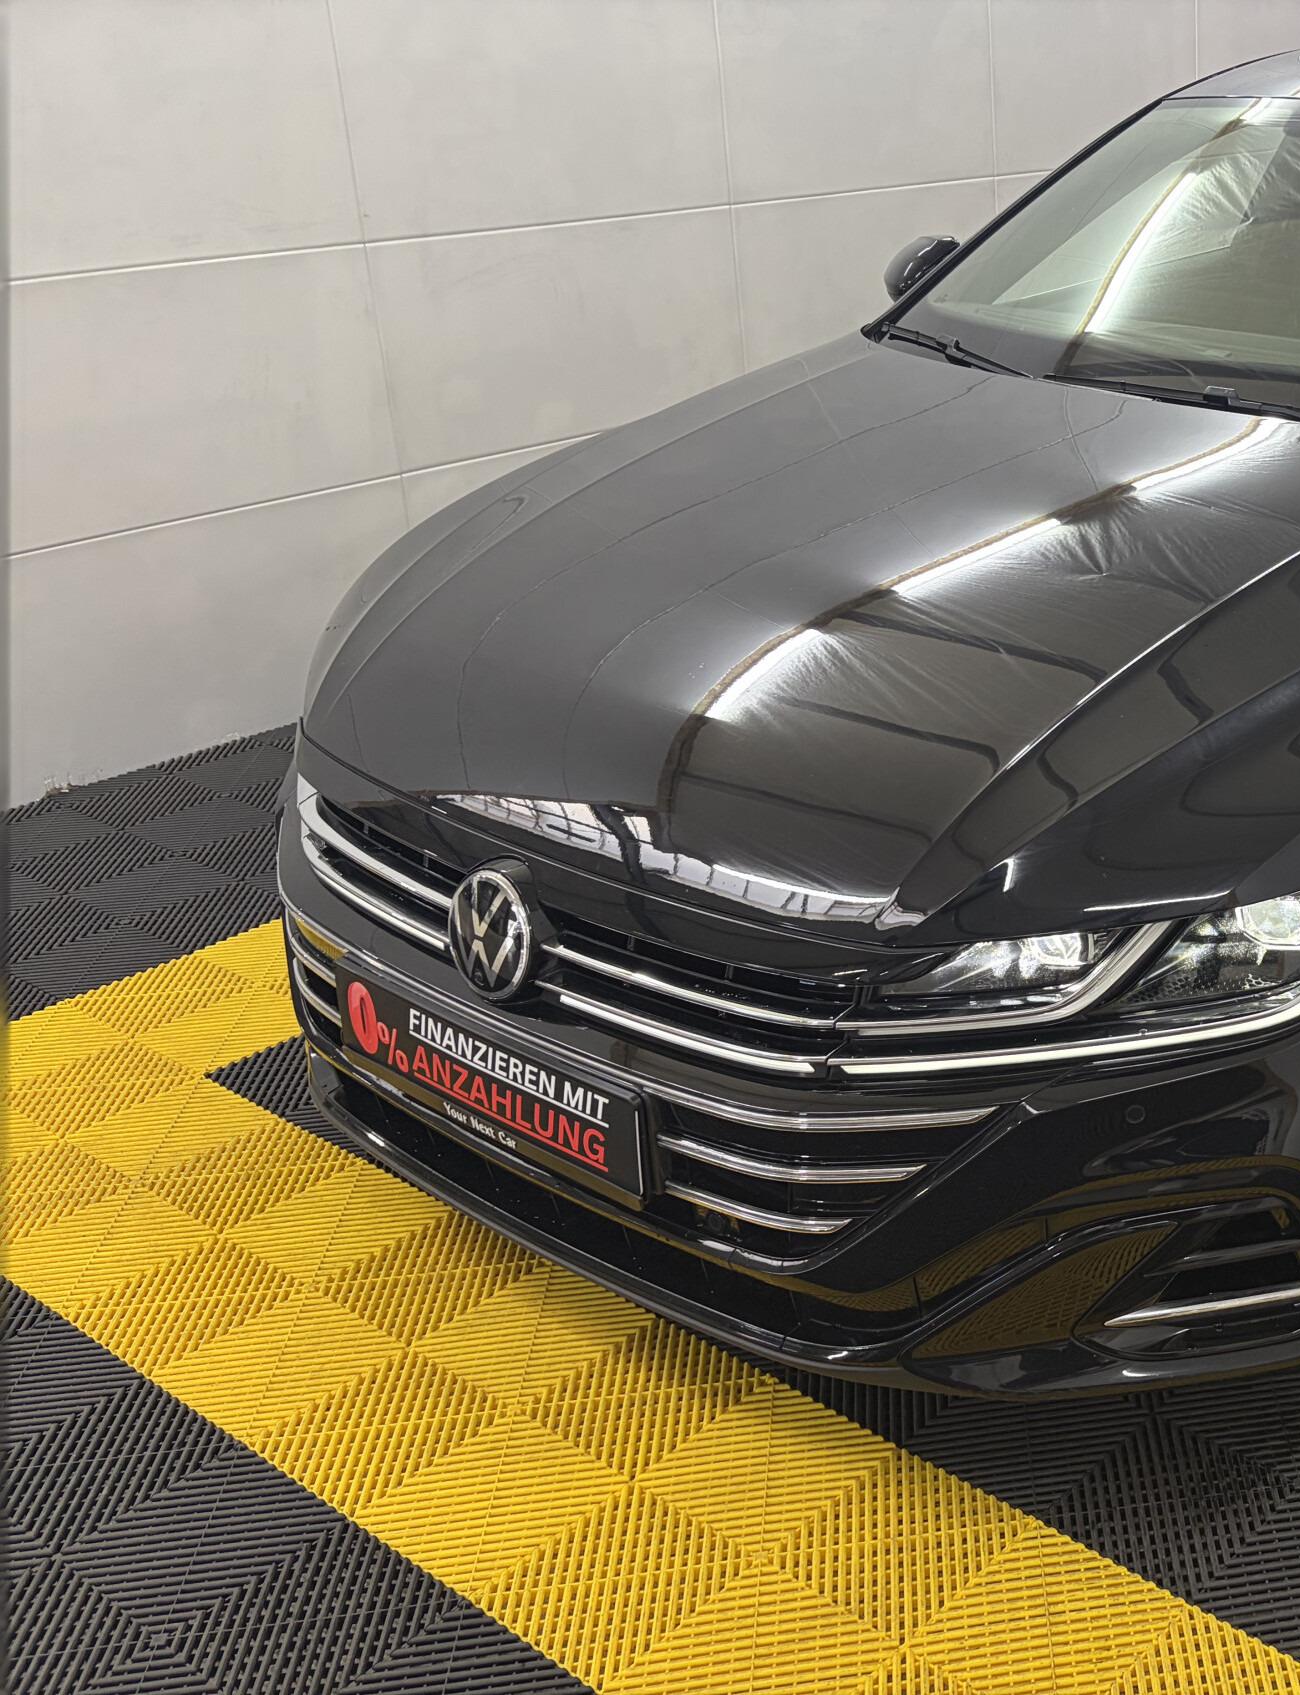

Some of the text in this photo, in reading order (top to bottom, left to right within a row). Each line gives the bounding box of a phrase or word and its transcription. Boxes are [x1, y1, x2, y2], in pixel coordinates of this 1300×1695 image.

[453, 872, 528, 993] VW
[347, 981, 605, 1164] 0% ANZAHLUNG
[409, 1008, 610, 1121] FINANZIEREN MIT
[443, 1101, 517, 1149] Your Next Car
